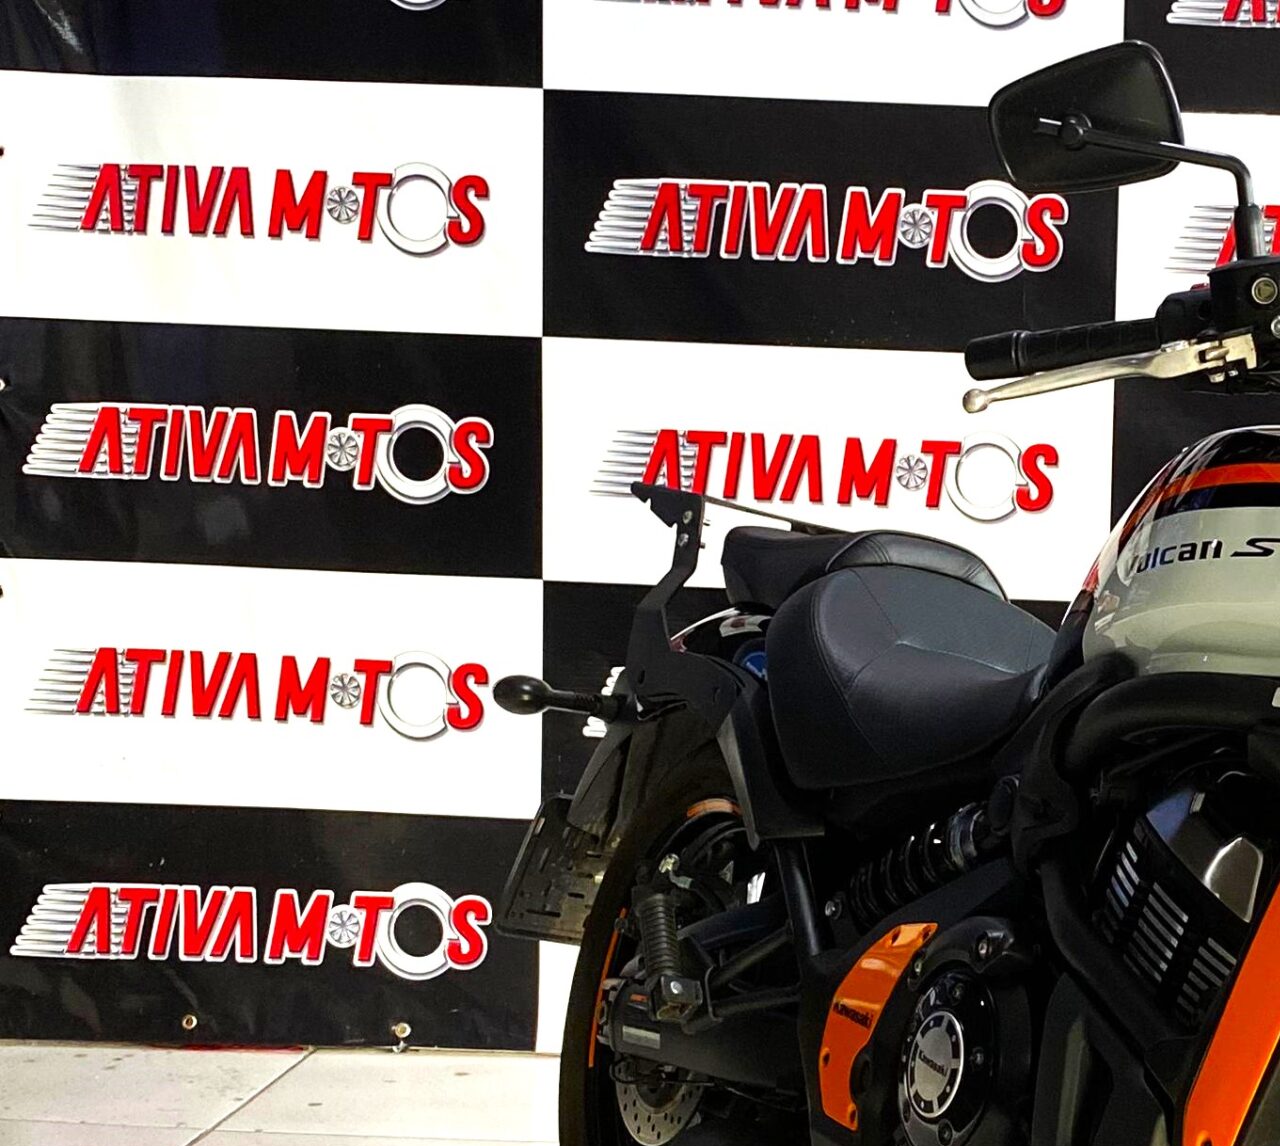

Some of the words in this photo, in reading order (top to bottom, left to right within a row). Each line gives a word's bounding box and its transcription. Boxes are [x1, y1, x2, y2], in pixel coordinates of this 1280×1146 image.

[80, 163, 254, 236] ATIVA
[268, 162, 490, 258] MOTOS
[639, 182, 828, 259] ATIVA
[840, 180, 1066, 283] MOTOS
[78, 406, 258, 481] ATIVA
[271, 404, 491, 505] MOTOS
[642, 428, 824, 504] ATIVA
[837, 432, 1060, 524] MOTOS
[76, 647, 261, 720] ATIVA
[274, 650, 490, 741] MOTOS
[66, 886, 254, 959] ATIVA
[269, 882, 490, 981] MOTOS
